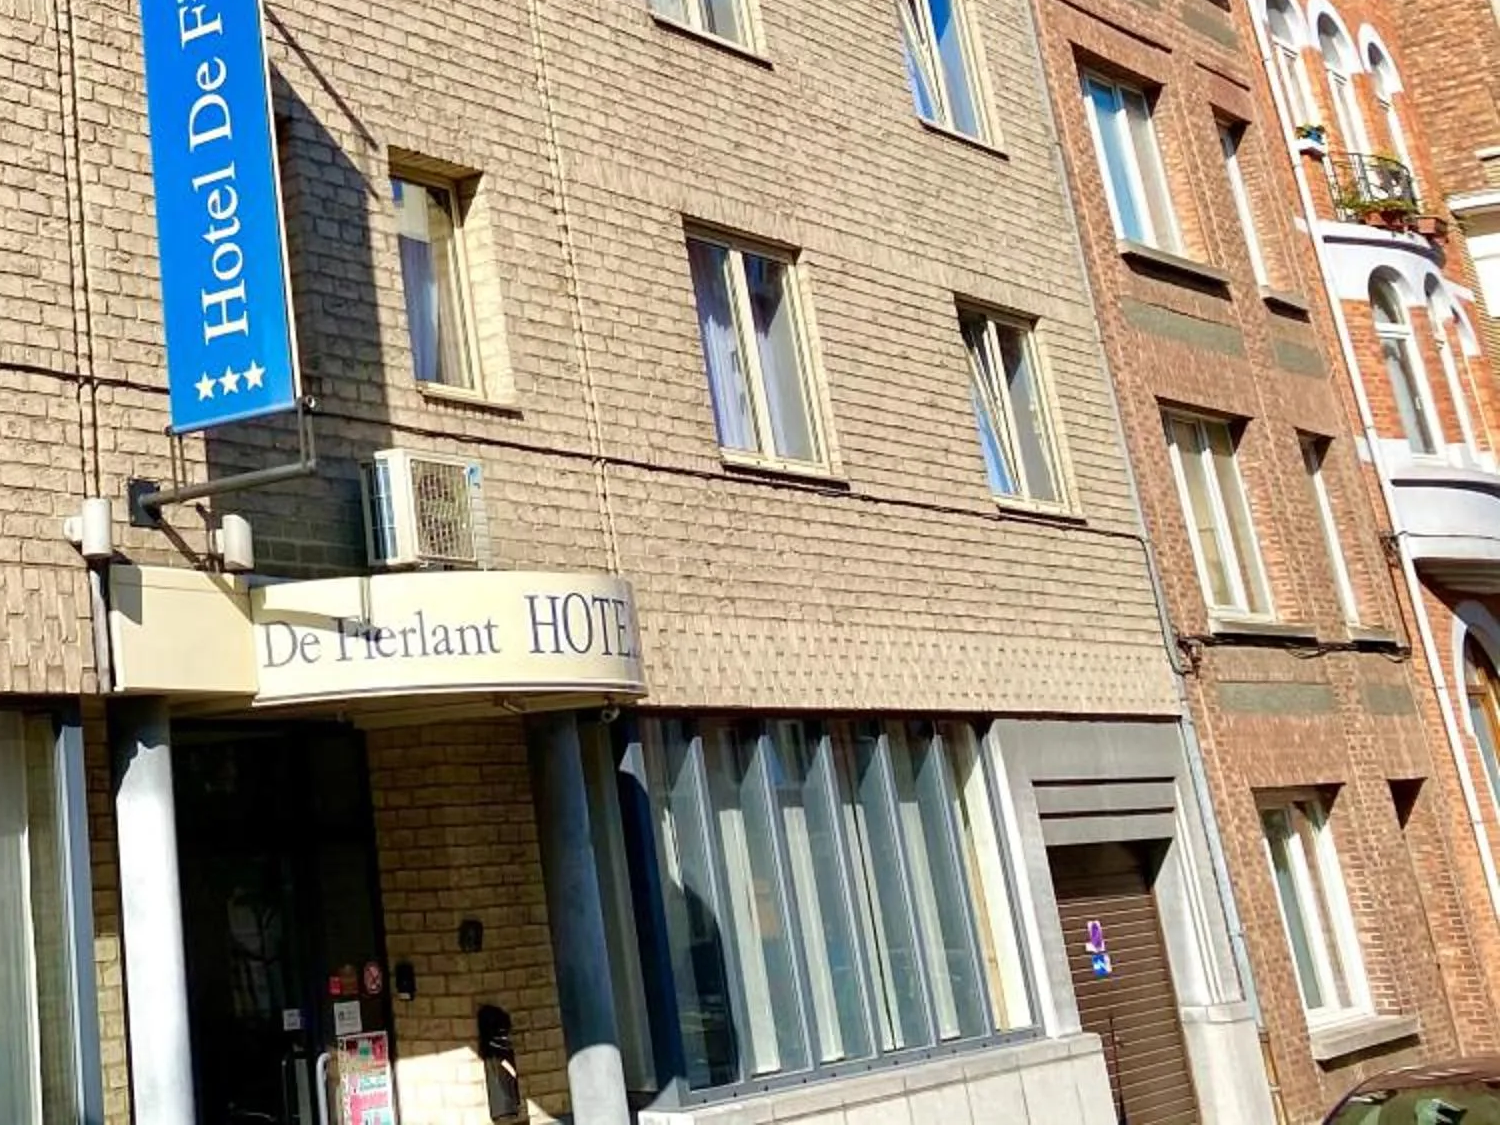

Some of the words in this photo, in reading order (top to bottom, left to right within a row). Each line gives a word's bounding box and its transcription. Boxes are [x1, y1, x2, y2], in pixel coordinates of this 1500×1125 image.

[189, 57, 233, 153] De
[192, 160, 249, 345] Hotel
[260, 620, 322, 668] De
[332, 609, 503, 662] Fierlant
